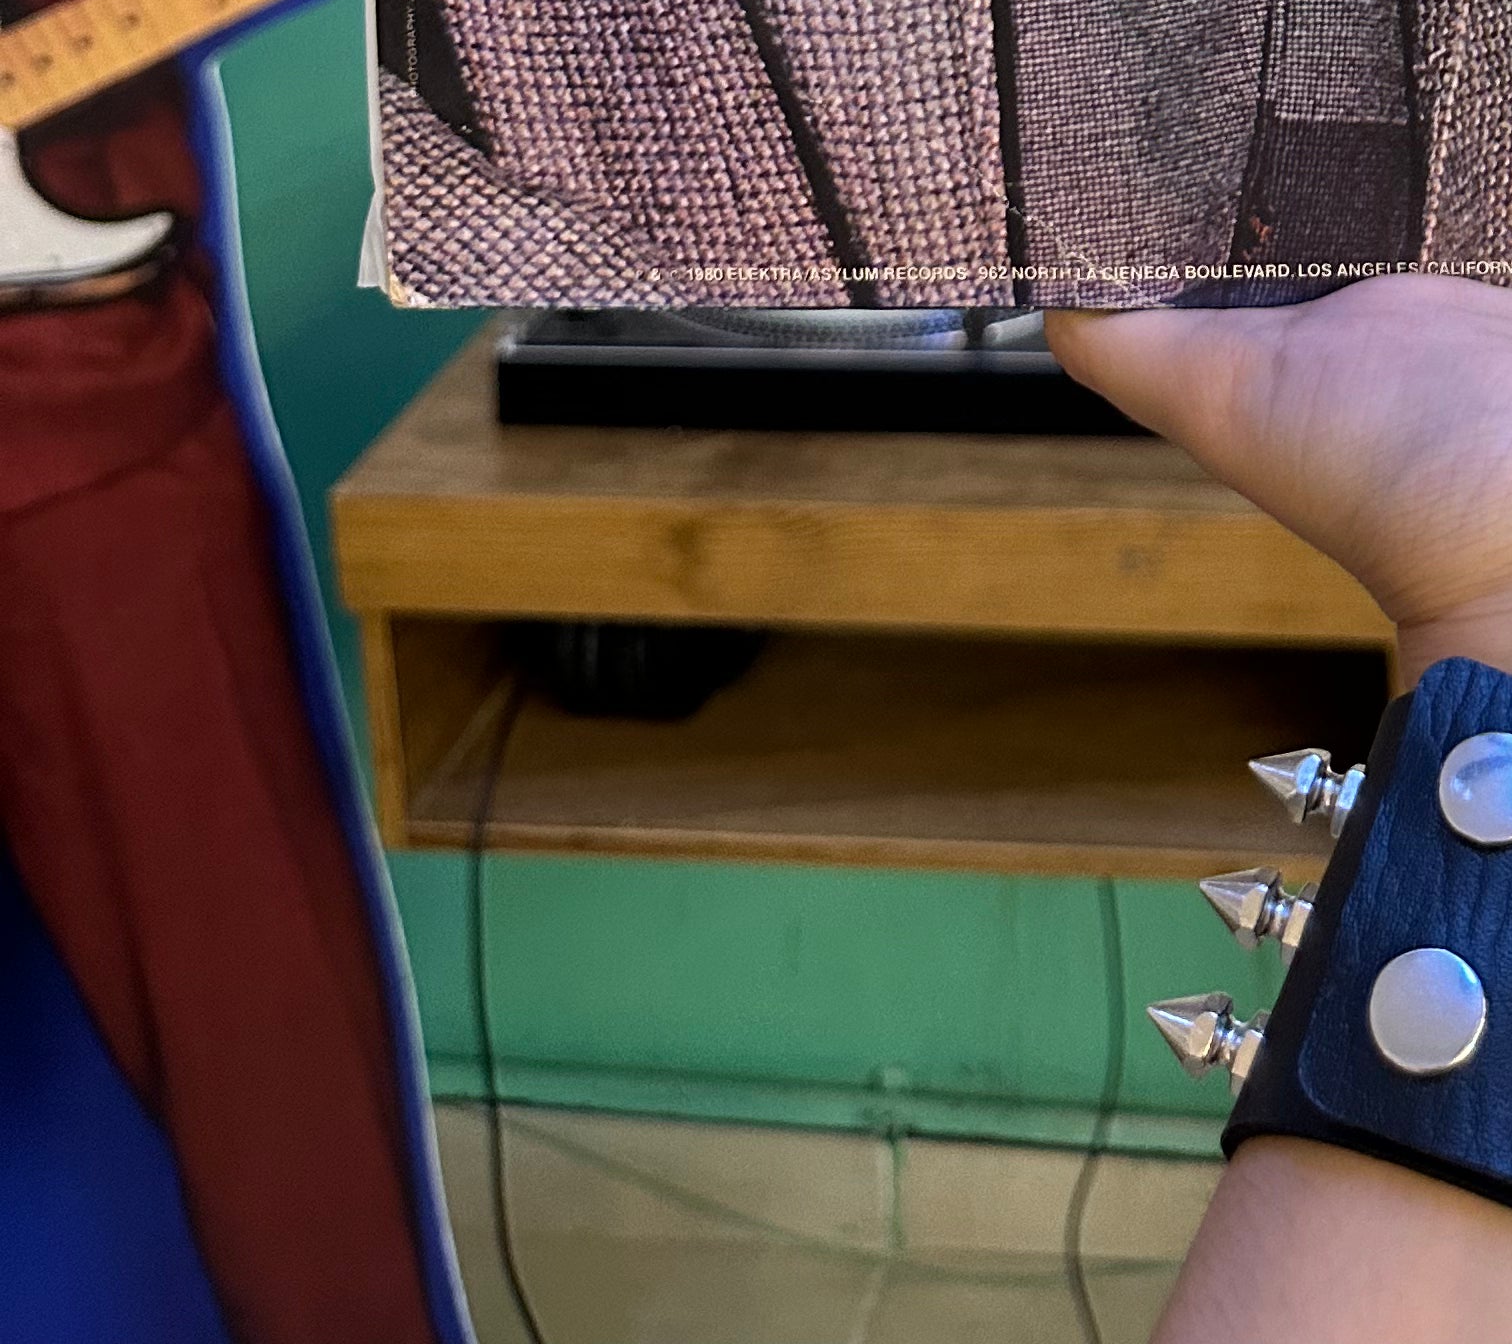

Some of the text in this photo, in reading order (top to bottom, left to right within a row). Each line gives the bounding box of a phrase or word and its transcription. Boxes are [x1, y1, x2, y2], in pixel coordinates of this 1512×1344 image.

[686, 267, 723, 281] 1980
[726, 267, 879, 281] ELEKTRA/ASYLUM
[884, 267, 967, 281] RECORDS
[978, 266, 1007, 280] 962
[1012, 266, 1071, 280] NORTH
[1076, 267, 1098, 280] LA
[1102, 265, 1179, 280] CIENEGA
[1298, 263, 1332, 277] LOS
